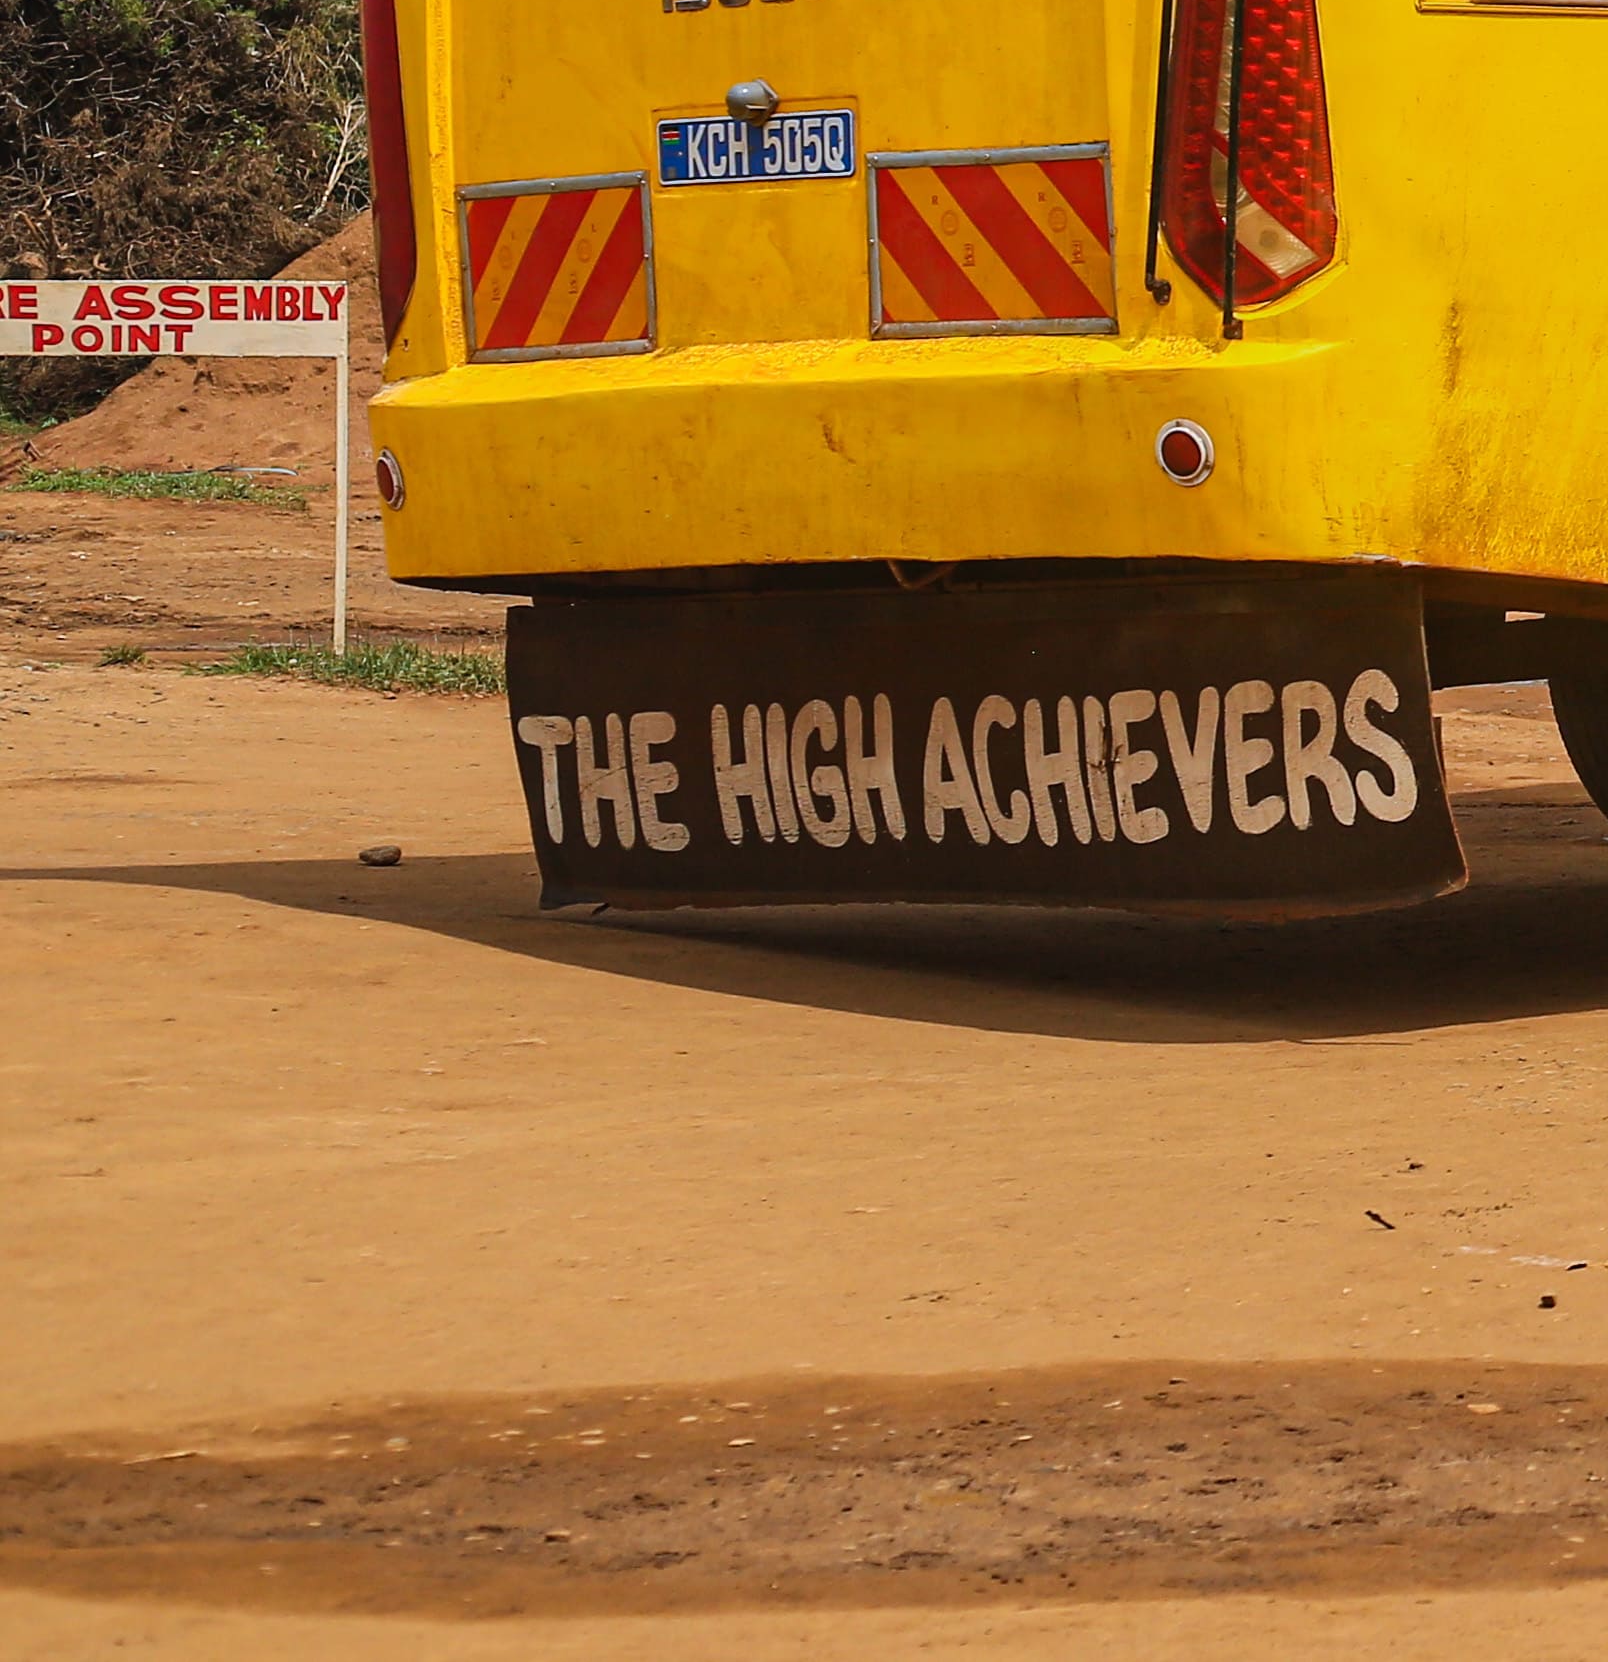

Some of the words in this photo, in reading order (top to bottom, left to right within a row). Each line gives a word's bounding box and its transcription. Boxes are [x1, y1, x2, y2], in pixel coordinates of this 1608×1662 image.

[687, 122, 749, 178] KCH
[763, 117, 845, 174] 505Q
[0, 285, 38, 319] E
[73, 285, 345, 321] ASSEMBLY
[32, 323, 193, 352] POINT
[517, 710, 690, 851] THE
[710, 693, 906, 848] HIGH
[922, 668, 1417, 846] ACHIEVERS
